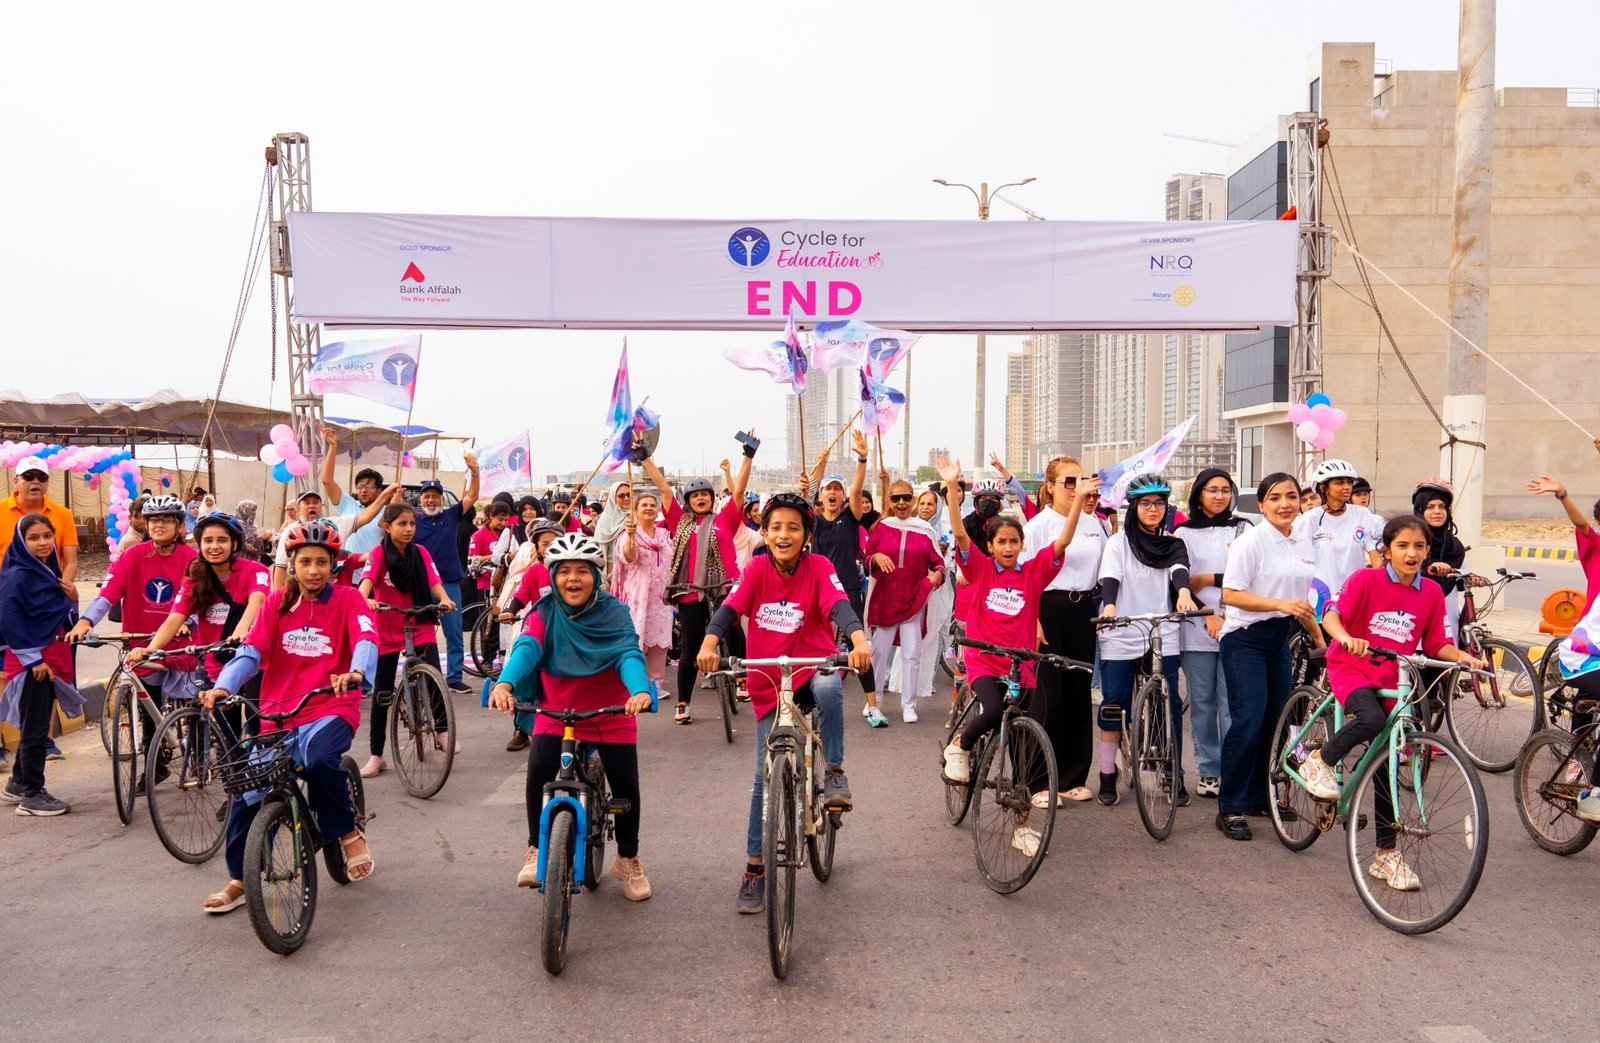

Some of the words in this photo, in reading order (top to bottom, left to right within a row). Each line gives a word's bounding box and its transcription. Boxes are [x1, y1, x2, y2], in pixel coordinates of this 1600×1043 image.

[781, 230, 838, 250] Cycle
[842, 233, 866, 247] for
[776, 248, 862, 269] Education
[1150, 255, 1193, 270] NRQ
[400, 285, 425, 294] Bank
[427, 286, 462, 294] Alfalah
[747, 280, 863, 316] END
[992, 592, 1009, 600] Cycle
[764, 606, 784, 616] Cycle
[785, 610, 795, 618] for
[760, 614, 793, 628] Education
[1378, 614, 1400, 626] Cycle
